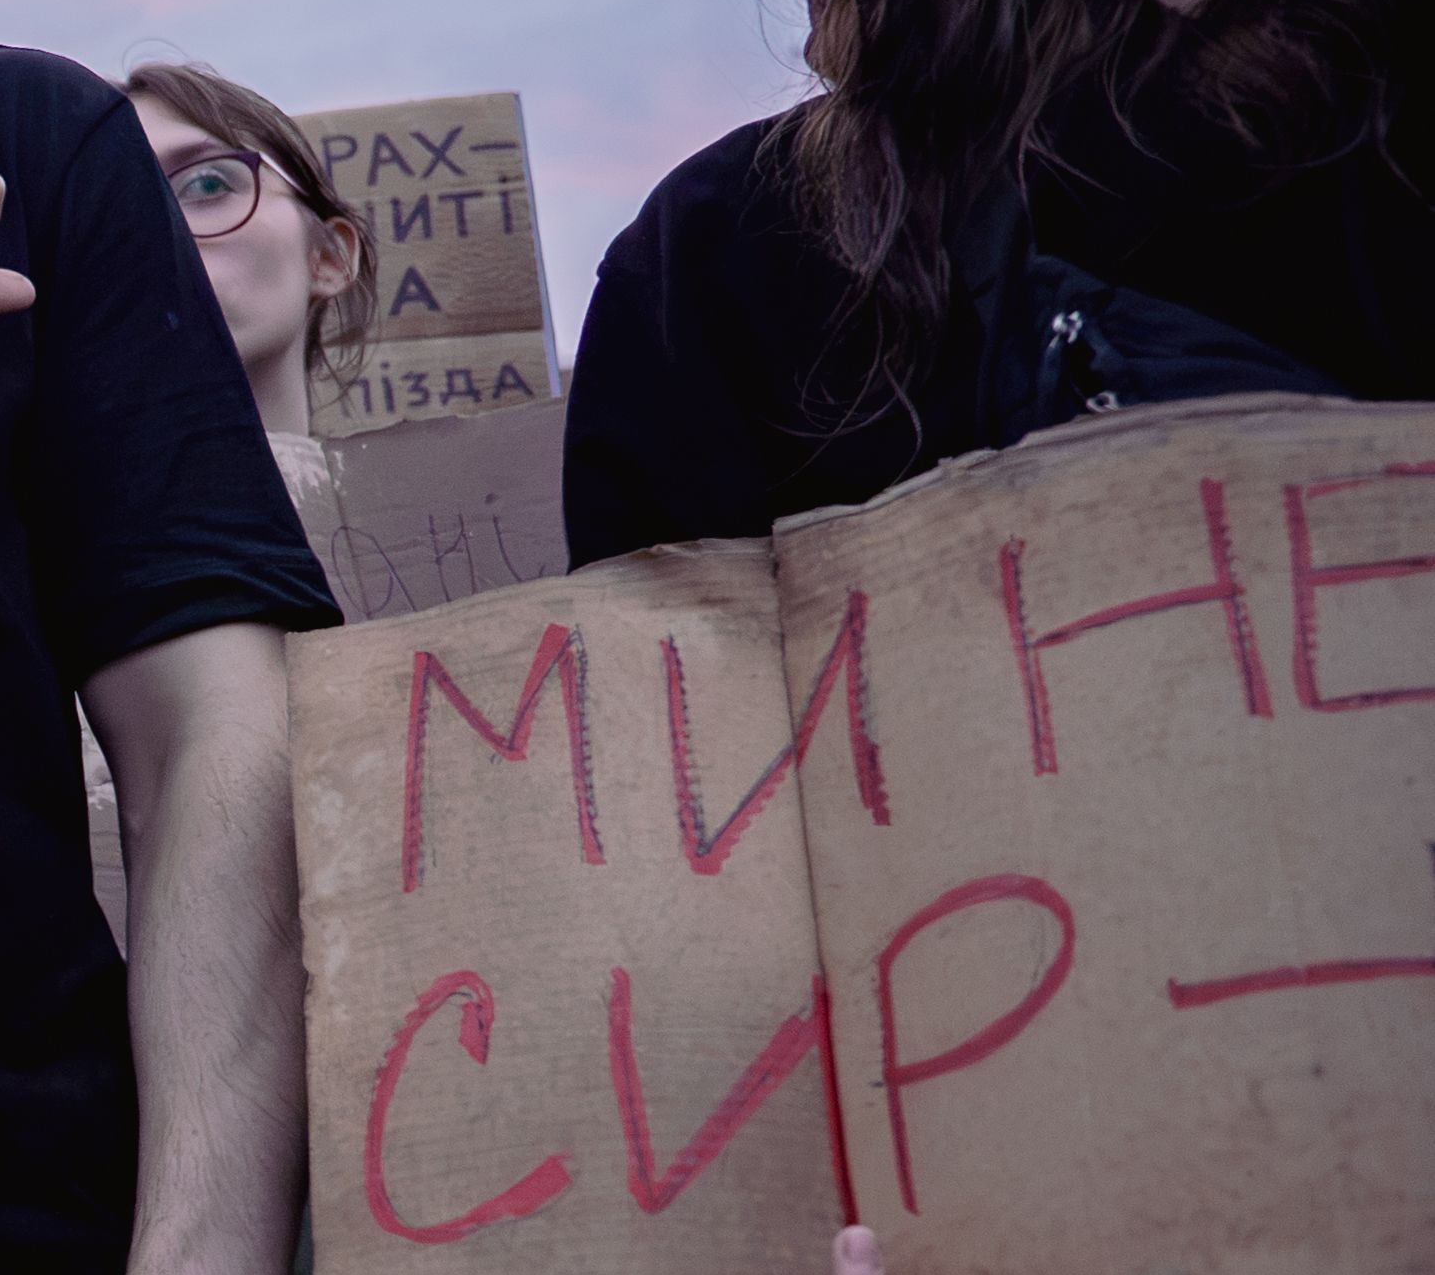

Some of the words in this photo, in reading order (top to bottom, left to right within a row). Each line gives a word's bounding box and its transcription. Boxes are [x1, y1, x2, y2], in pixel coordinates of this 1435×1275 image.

[400, 587, 892, 892] МИ
[998, 460, 1435, 778] НЕ
[364, 872, 1077, 1245] СИР
